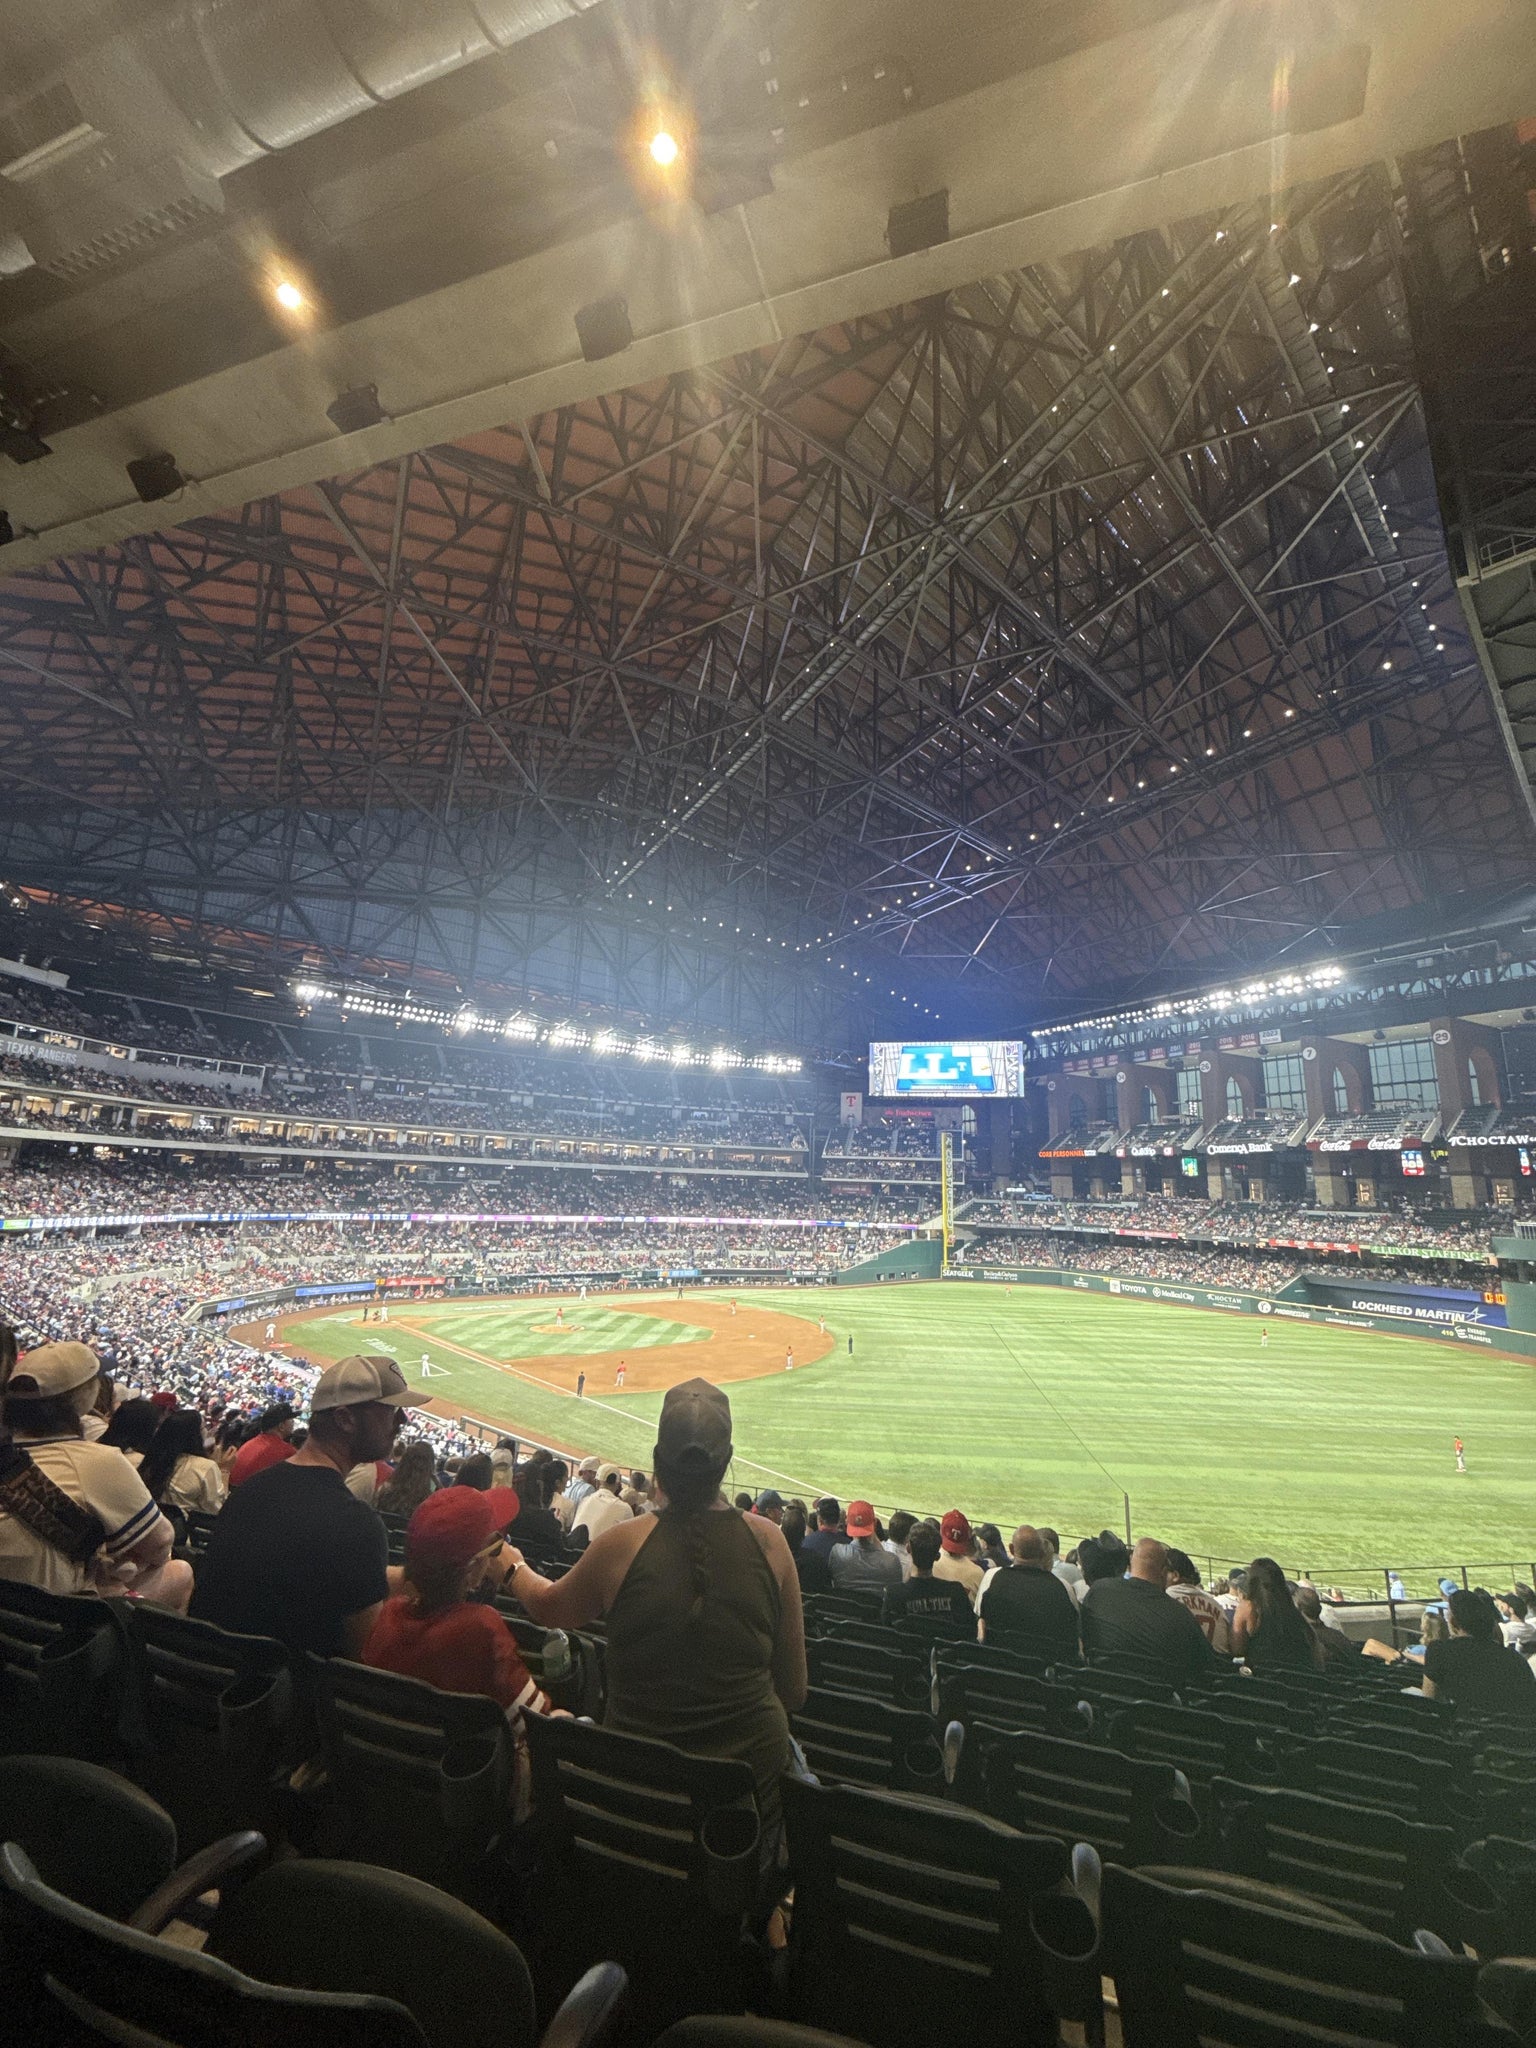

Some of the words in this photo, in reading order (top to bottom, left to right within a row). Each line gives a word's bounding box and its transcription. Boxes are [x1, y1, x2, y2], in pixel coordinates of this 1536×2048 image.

[1435, 1032, 1448, 1042] 29
[7, 1041, 35, 1055] TEXAS
[37, 1047, 77, 1064] RANGERS
[1306, 1049, 1313, 1058] 7
[846, 1096, 857, 1107] T
[1320, 1140, 1351, 1151] Coca-Cola
[1368, 1138, 1402, 1150] Coca-Cola
[1456, 1135, 1530, 1146] CHOCTAW
[1248, 1142, 1273, 1152] Bank
[1381, 1248, 1418, 1256] LUXOR
[1422, 1250, 1481, 1260] STAFFING
[1121, 1284, 1147, 1294] TOYOTA
[1352, 1300, 1412, 1316] LOCKHEED
[1415, 1308, 1465, 1322] MARTIN
[951, 1528, 962, 1542] T
